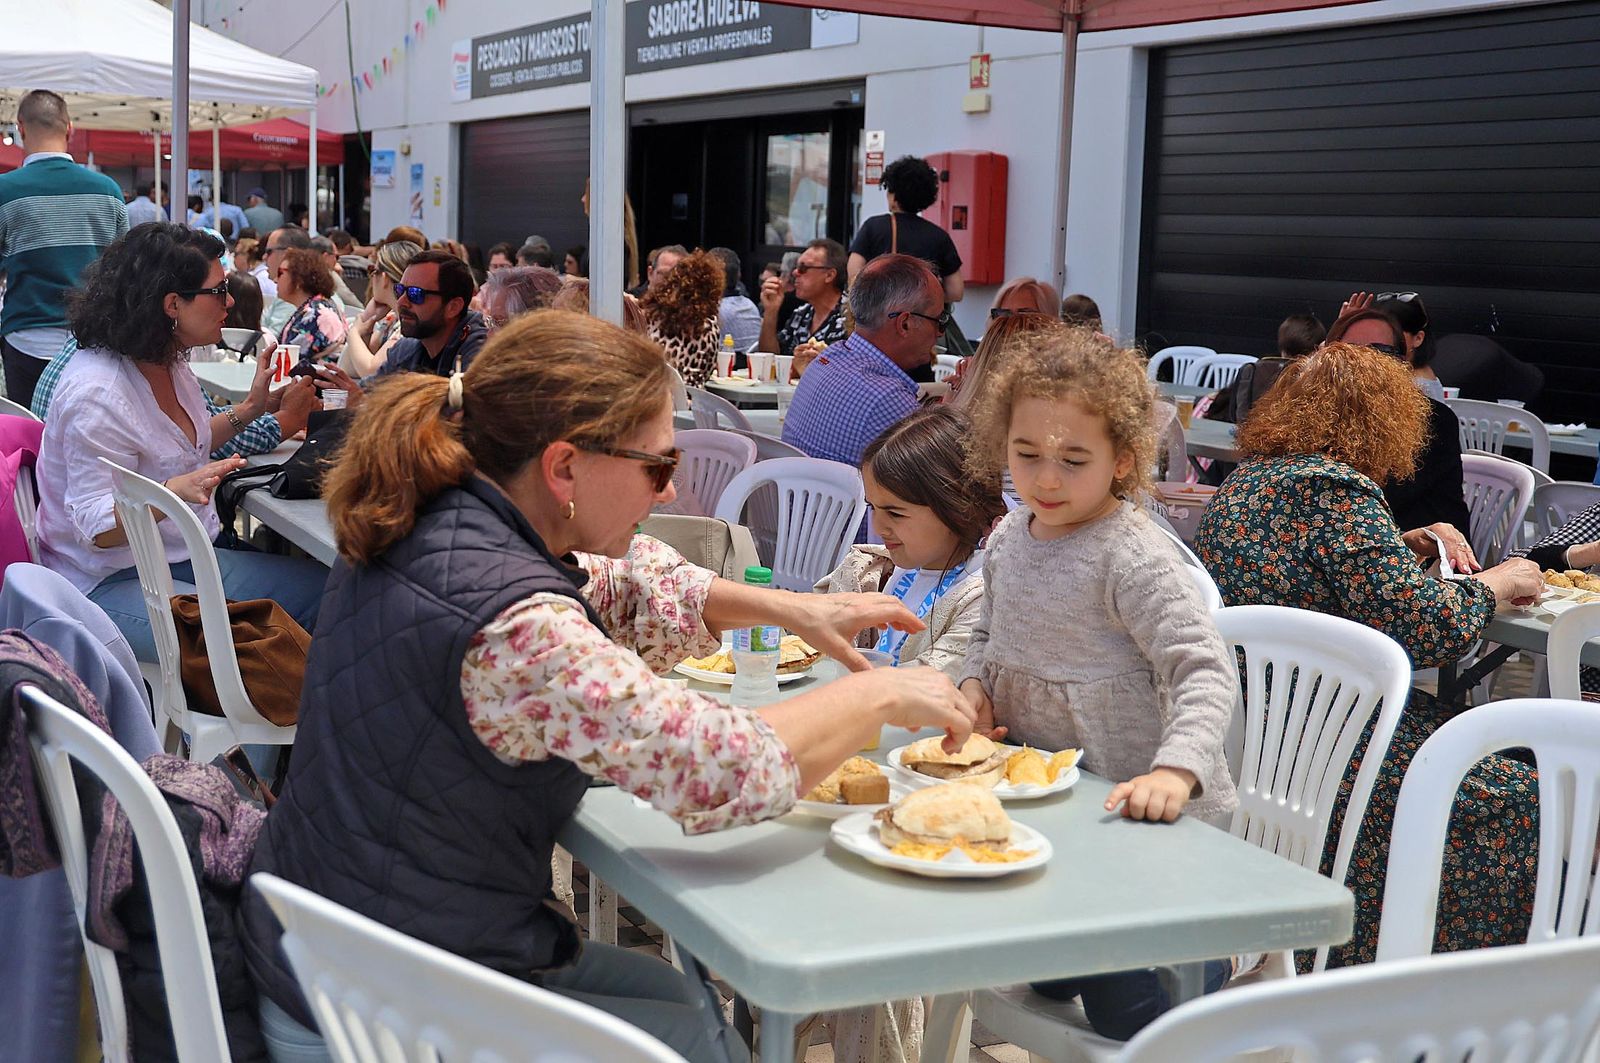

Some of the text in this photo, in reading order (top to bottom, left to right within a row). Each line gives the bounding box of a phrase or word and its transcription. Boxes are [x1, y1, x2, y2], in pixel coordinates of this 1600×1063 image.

[648, 0, 760, 38] SABOREA HUELVA
[478, 21, 591, 71] PESCADOS Y MARISCOS TO
[638, 45, 660, 62] TIENDA
[660, 41, 682, 60] ONLINE
[687, 38, 708, 55] VENTA
[714, 26, 773, 50] PROFESIONALES
